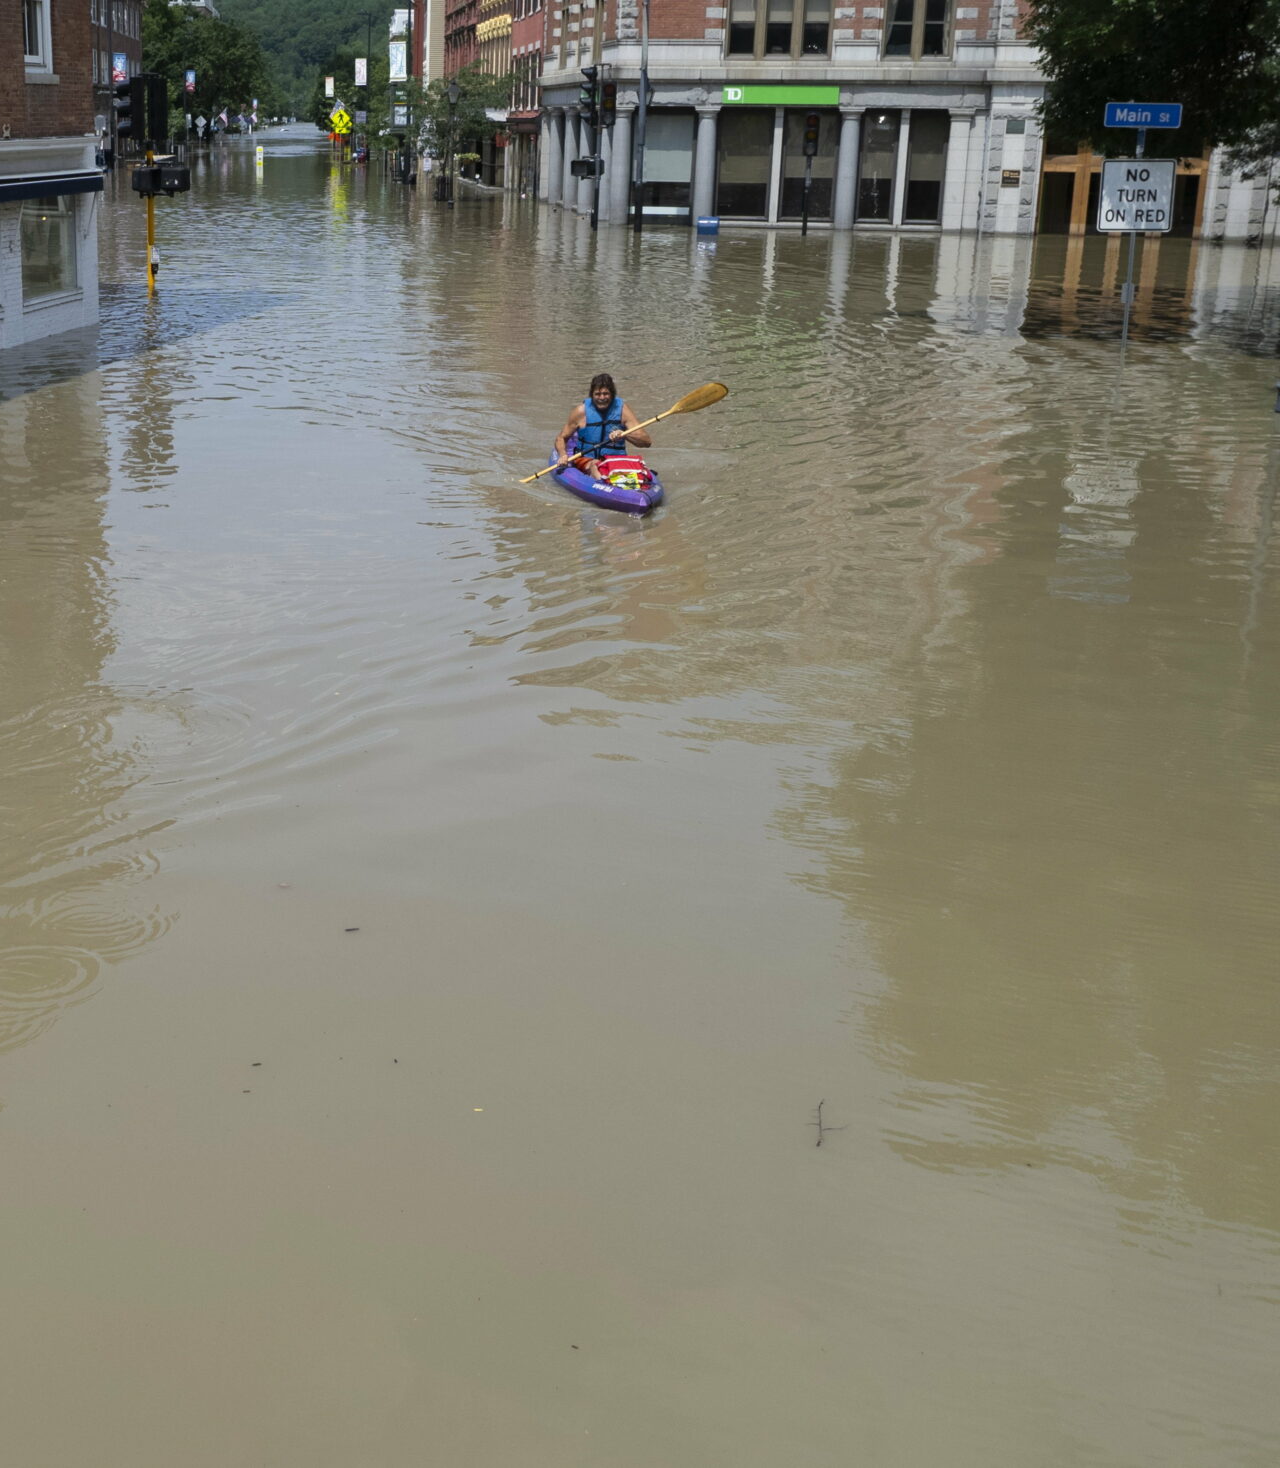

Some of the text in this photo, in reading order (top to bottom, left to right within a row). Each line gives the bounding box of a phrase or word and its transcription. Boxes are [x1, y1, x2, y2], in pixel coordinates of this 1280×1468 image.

[724, 88, 742, 101] TD
[1115, 108, 1170, 123] Main St
[1126, 168, 1150, 182] NO
[1117, 188, 1158, 203] TURN
[1105, 209, 1166, 223] ON RED
